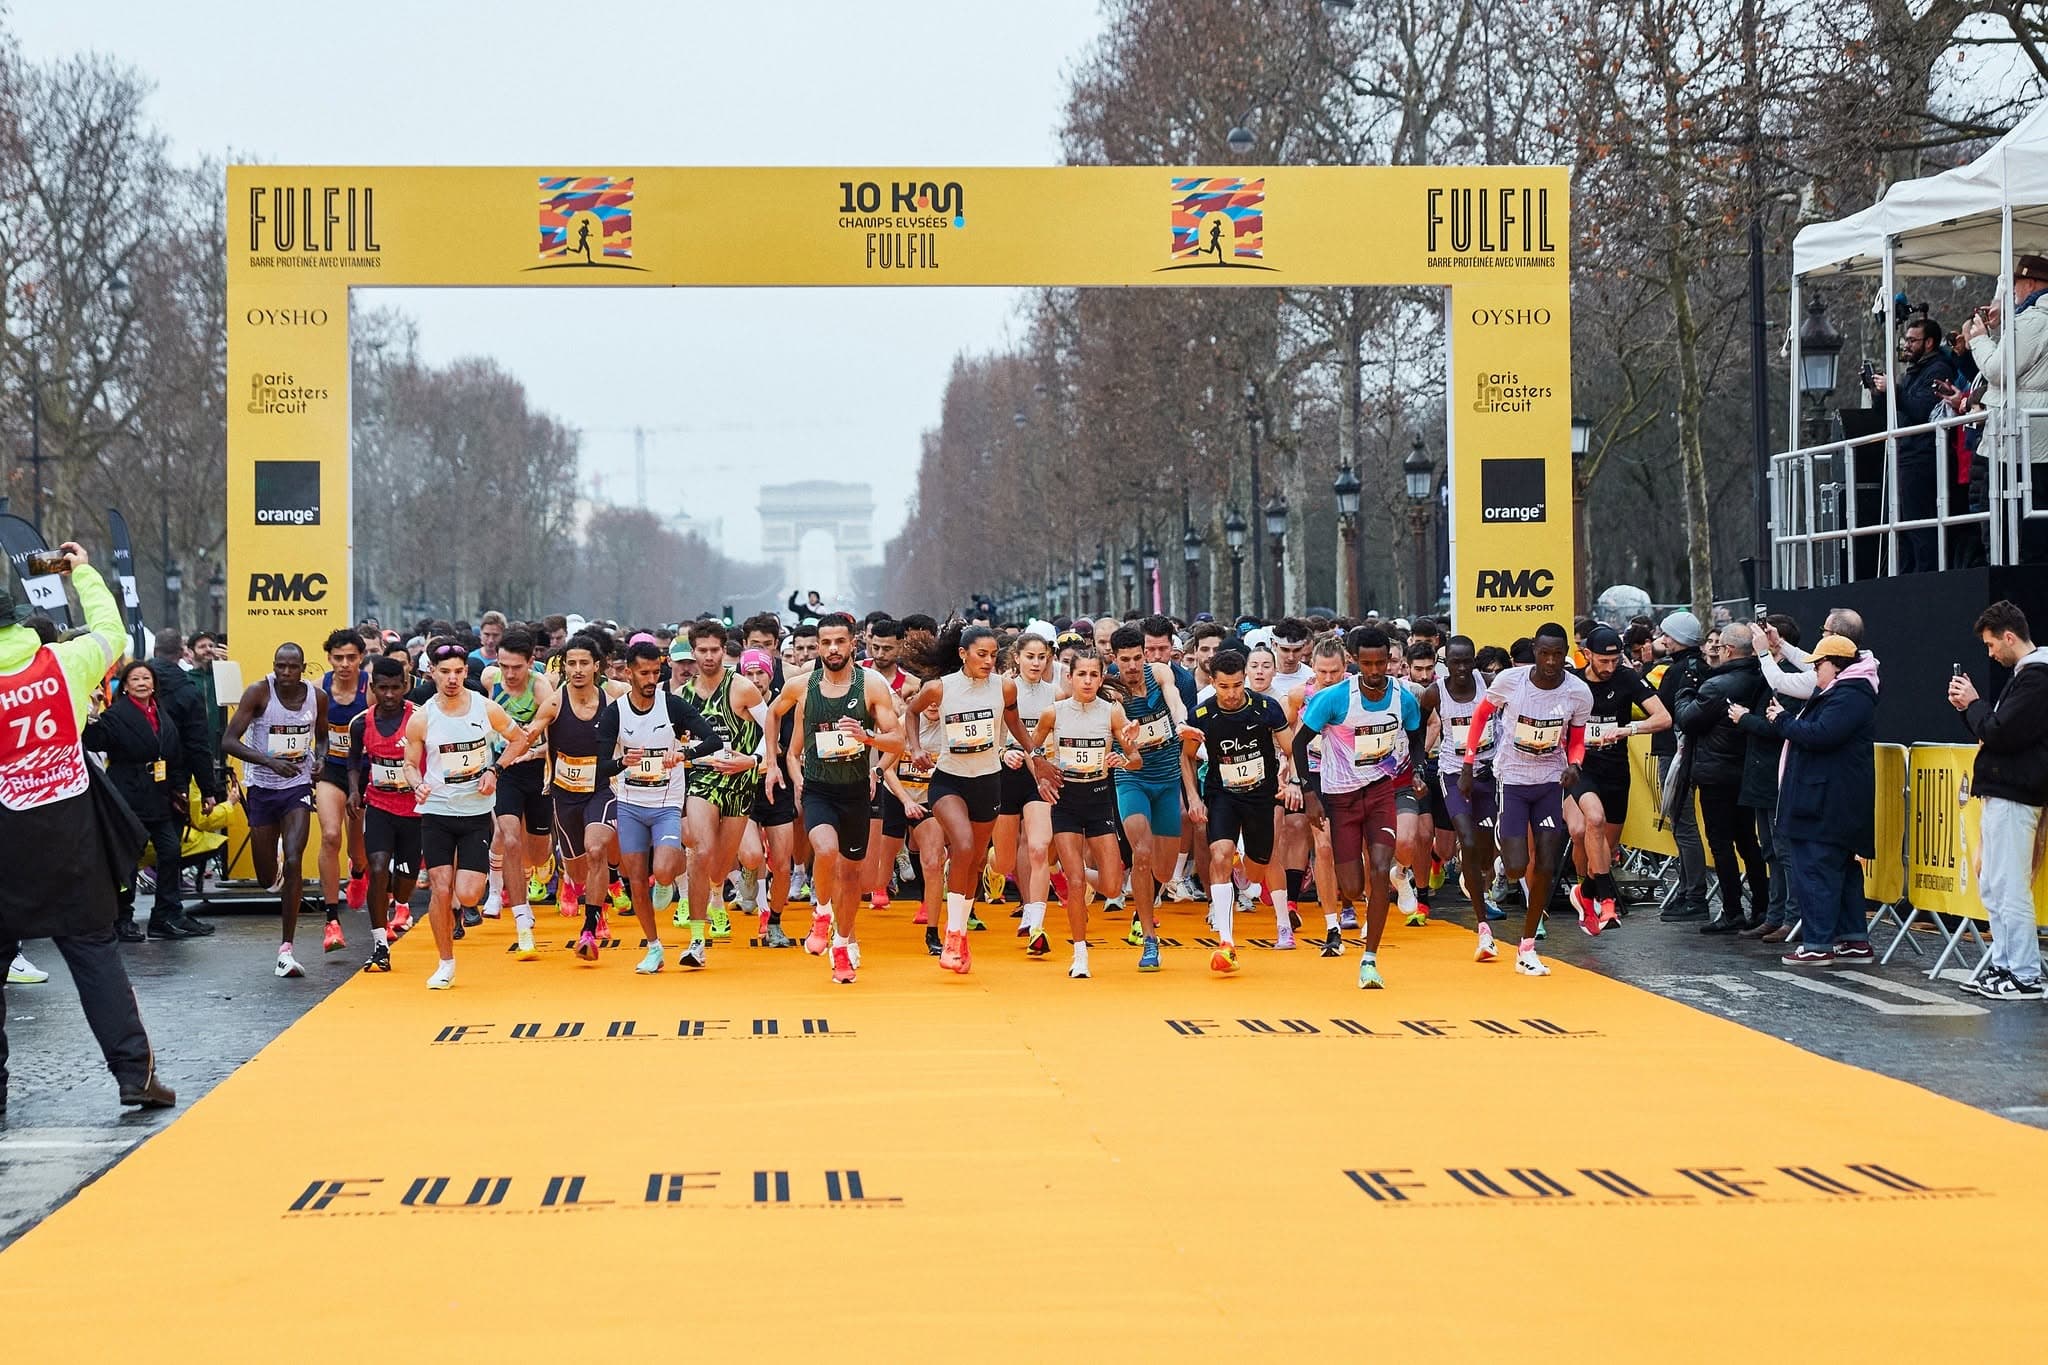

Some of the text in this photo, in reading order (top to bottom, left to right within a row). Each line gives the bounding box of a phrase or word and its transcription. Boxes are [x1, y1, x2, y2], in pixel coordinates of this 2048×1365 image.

[839, 181, 881, 213] 10
[250, 187, 381, 252] FULFIL
[838, 214, 948, 228] CHAMPS ELYSÉES
[1427, 188, 1555, 252] FULFIL
[866, 233, 939, 269] FULFIL
[250, 256, 275, 268] BARRE
[319, 256, 338, 268] AVEC
[339, 256, 381, 268] VITAMINES
[1427, 255, 1555, 268] BARRE PROTÉINÉE AVEC VITAMINES
[247, 308, 328, 326] OYSHO
[1471, 308, 1551, 326] OYSHO
[248, 573, 328, 602] RMC
[1476, 568, 1554, 598] RMC
[247, 608, 328, 616] INFO TALK SPORT
[1476, 605, 1497, 613] INFO
[1525, 604, 1555, 612] SPORT
[9, 708, 58, 749] 76
[964, 724, 977, 738] 58
[1147, 725, 1155, 737] 3
[1533, 730, 1544, 741] 14
[1590, 726, 1601, 737] 18
[286, 737, 297, 749] 13
[338, 735, 351, 746] 16
[837, 733, 844, 747] 8
[1220, 737, 1258, 754] Plus
[1376, 736, 1381, 749] 1
[462, 754, 470, 767] 2
[1076, 751, 1089, 763] 55
[567, 767, 581, 778] 157
[640, 760, 651, 773] 10
[1236, 765, 1249, 778] 12
[385, 769, 397, 781] 15
[1915, 768, 1955, 869] FULFIL
[433, 1018, 857, 1042] FULFIL
[1164, 1018, 1598, 1037] FULFIL
[288, 1169, 904, 1211] FULFIL
[1341, 1164, 1979, 1202] FULFIL
